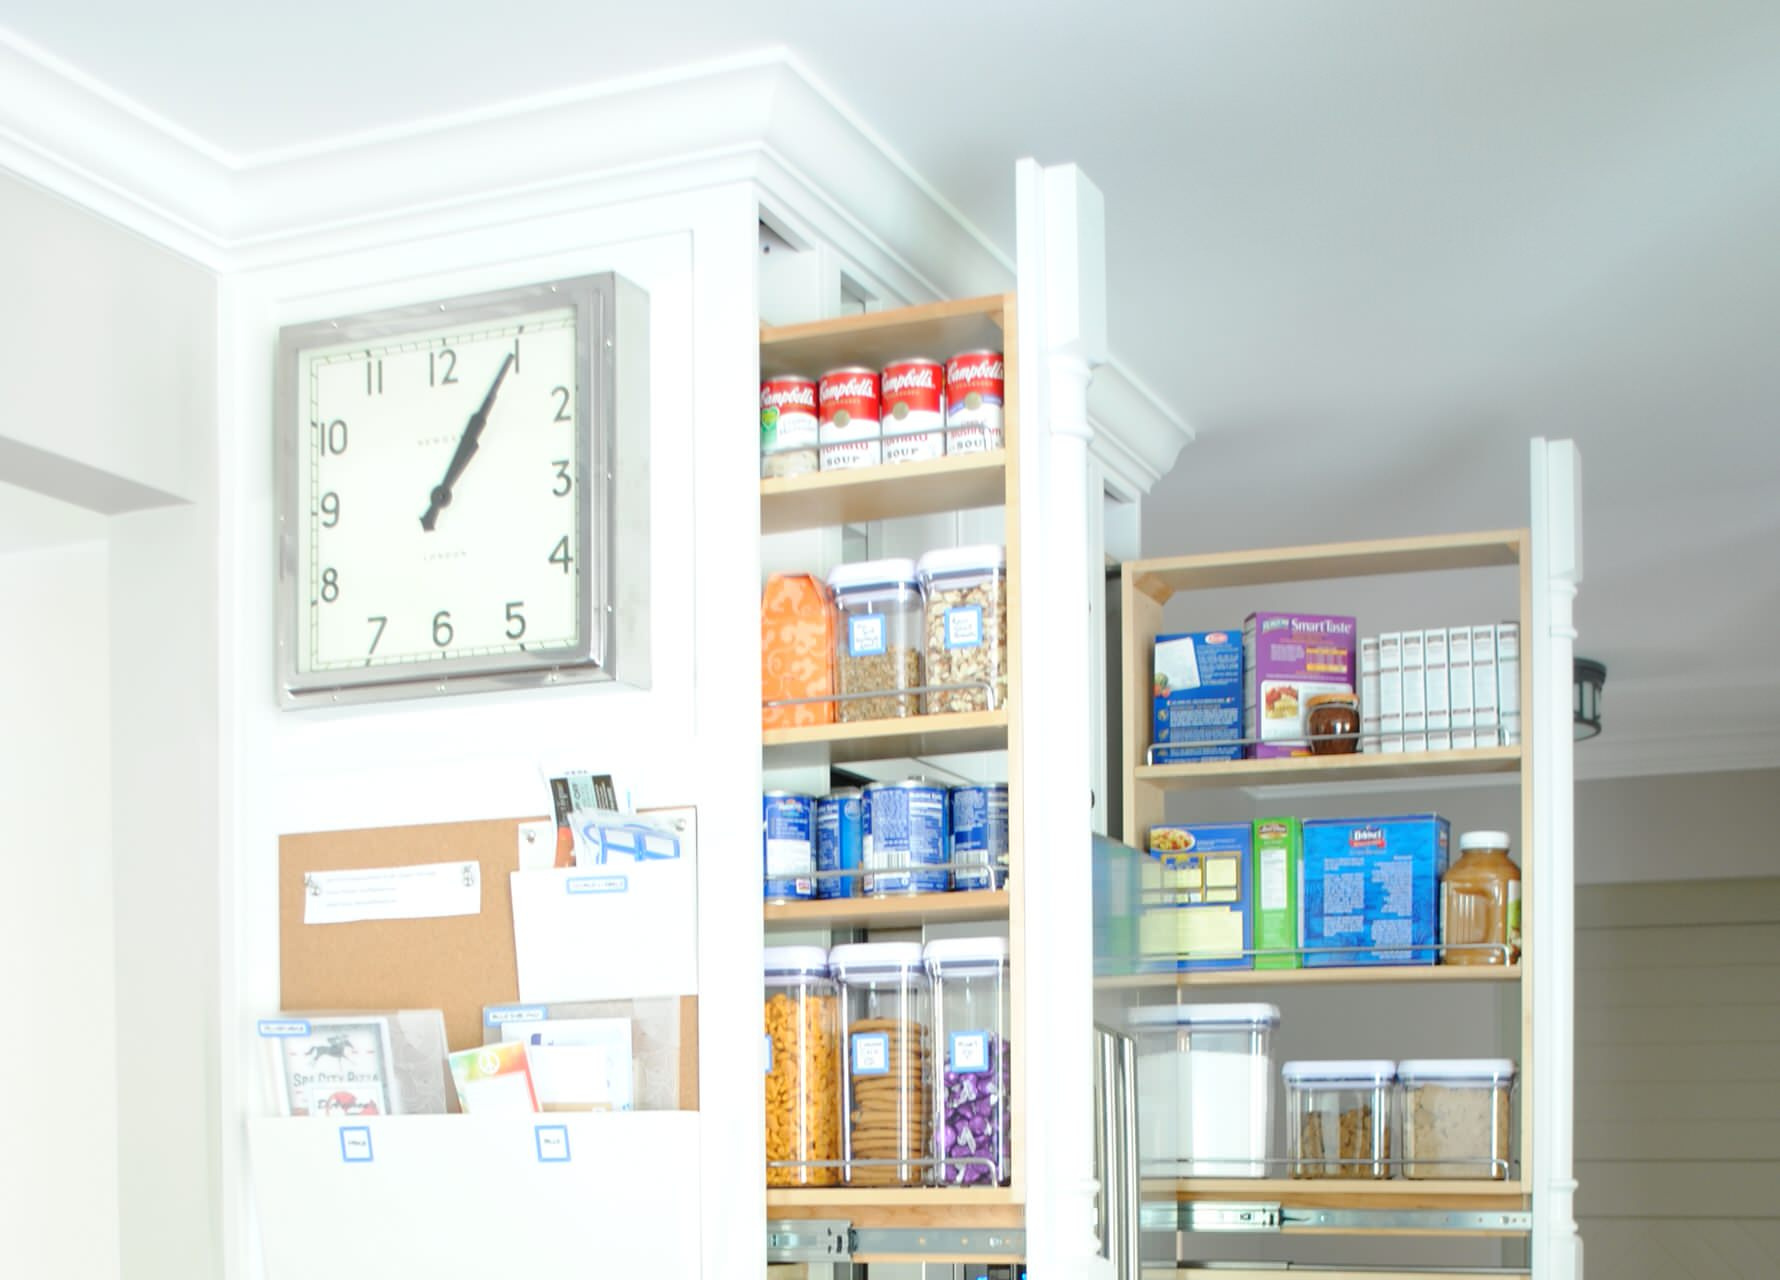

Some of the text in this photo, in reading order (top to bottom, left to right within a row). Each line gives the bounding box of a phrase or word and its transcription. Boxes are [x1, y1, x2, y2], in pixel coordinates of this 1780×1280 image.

[366, 360, 384, 396] 11
[429, 349, 459, 387] 12
[882, 369, 936, 393] Campbell's
[551, 386, 573, 422] 2
[820, 377, 876, 402] Campbell's
[320, 419, 349, 456] 10
[887, 447, 919, 460] SOUP
[551, 460, 573, 497] 3
[826, 455, 861, 466] SOUP
[320, 491, 340, 528] 9
[548, 535, 574, 574] 4
[320, 567, 340, 603] 8
[367, 616, 389, 656] 7
[432, 610, 454, 647] 6
[505, 602, 527, 640] 5
[1291, 618, 1326, 633] Smart
